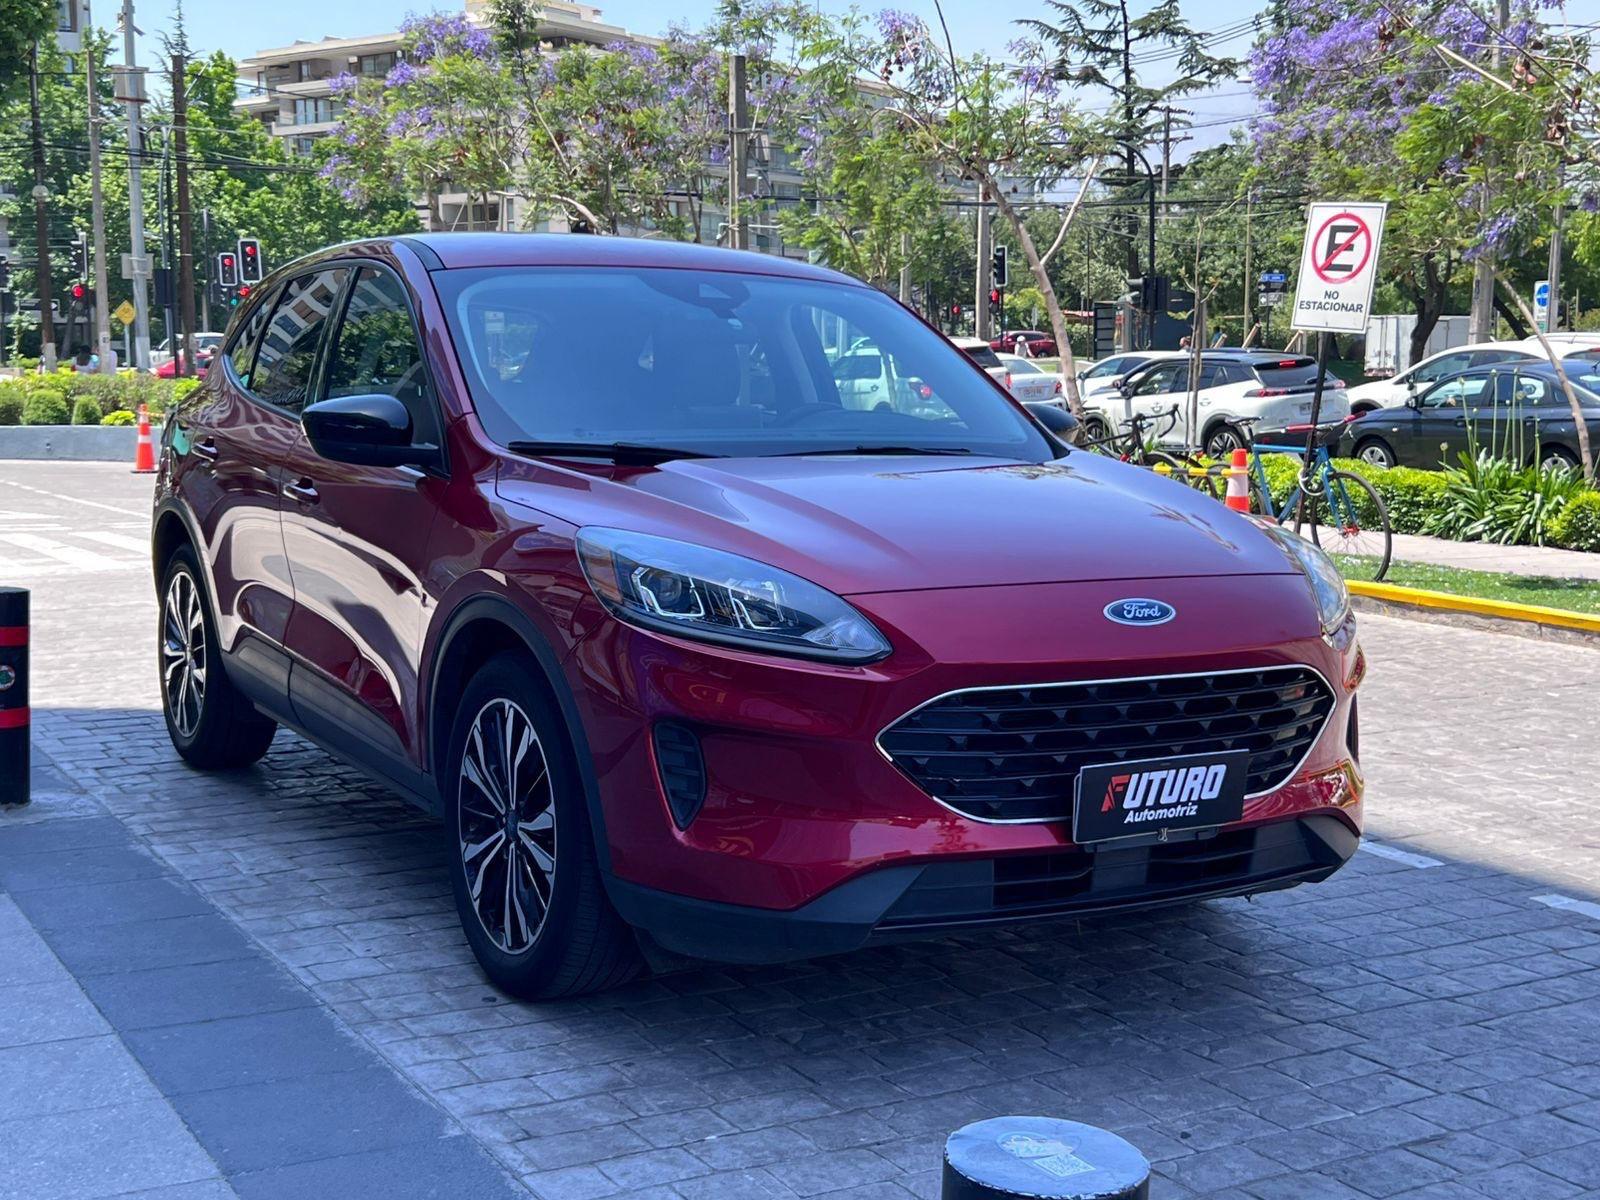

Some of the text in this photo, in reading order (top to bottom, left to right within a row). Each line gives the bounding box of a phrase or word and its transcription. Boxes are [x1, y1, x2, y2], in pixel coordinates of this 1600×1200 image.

[1323, 225, 1359, 272] E
[1324, 290, 1339, 300] NO
[1299, 300, 1364, 313] ESTACIONAR
[1123, 602, 1162, 618] Ford
[1101, 764, 1227, 812] FUTURO
[1123, 802, 1198, 824] Automotriz
